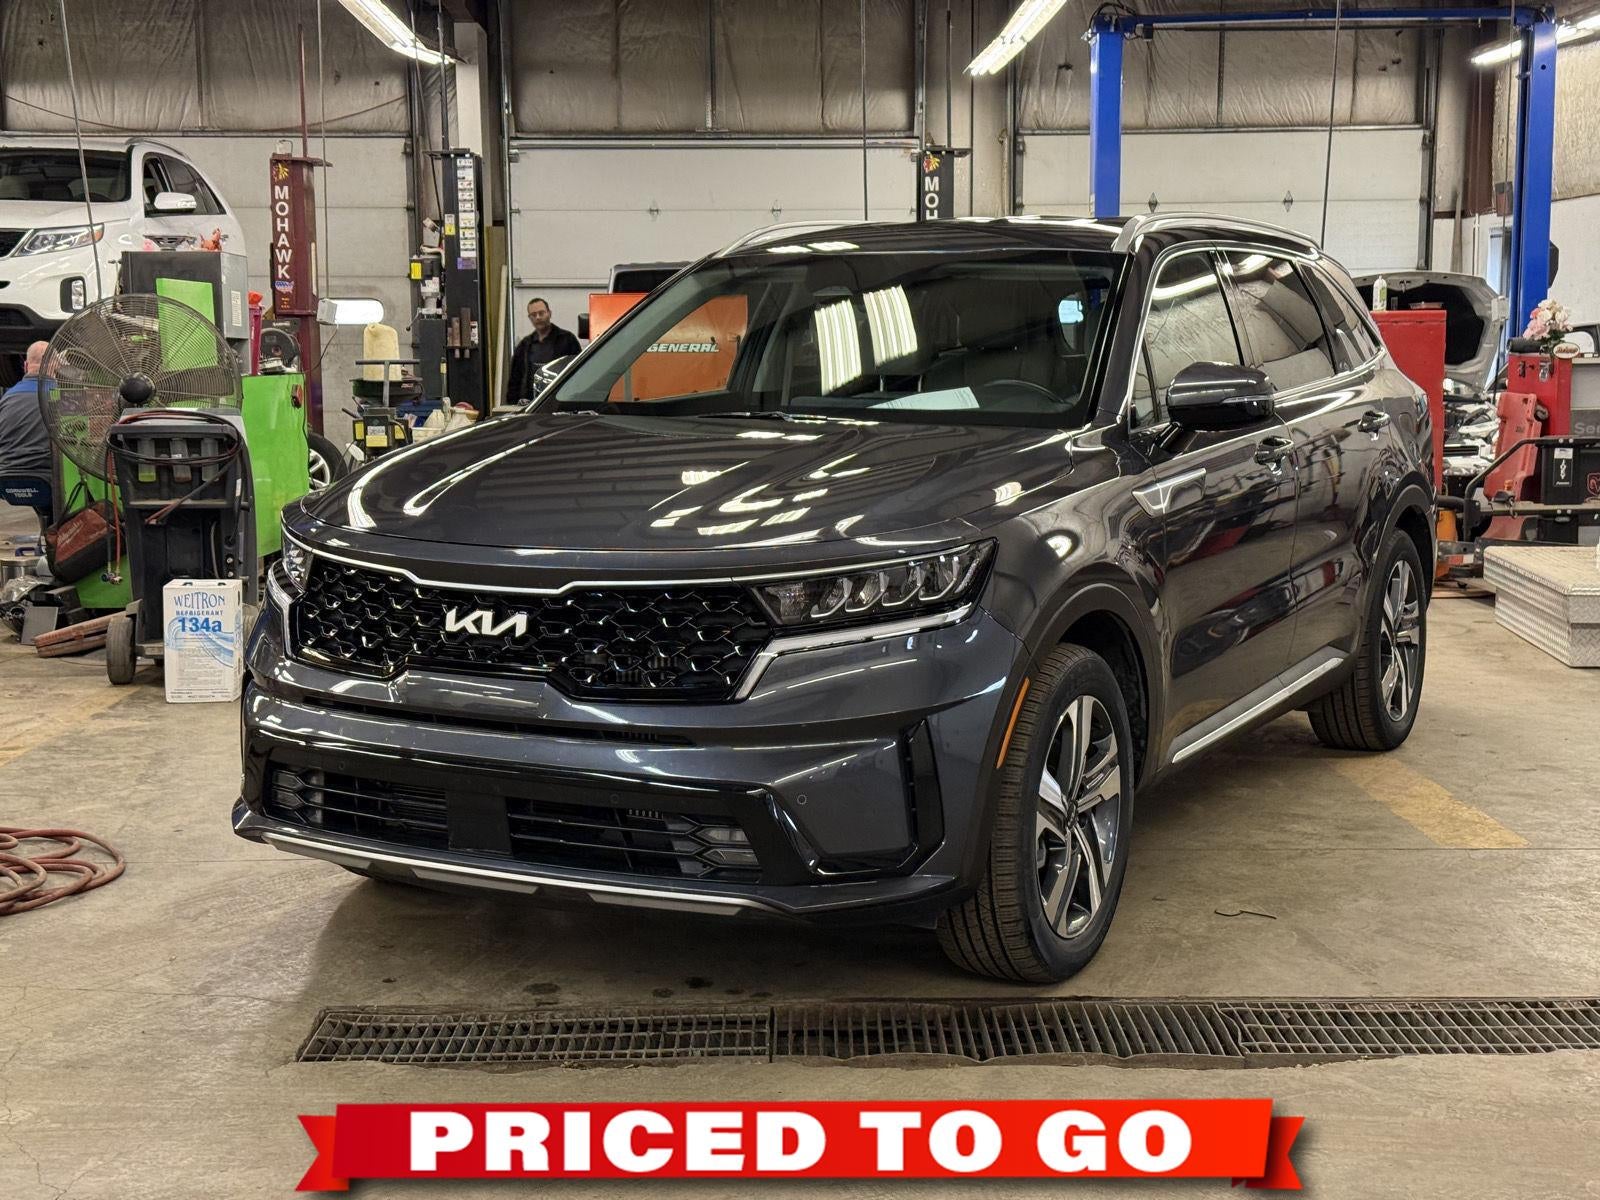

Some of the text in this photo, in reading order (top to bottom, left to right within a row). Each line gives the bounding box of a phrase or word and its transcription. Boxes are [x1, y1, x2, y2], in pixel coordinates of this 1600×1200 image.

[274, 185, 293, 280] MOHAWK
[647, 343, 720, 353] GENERAL
[173, 591, 226, 610] WEITRON
[178, 617, 222, 633] 134a
[445, 608, 528, 638] KIA
